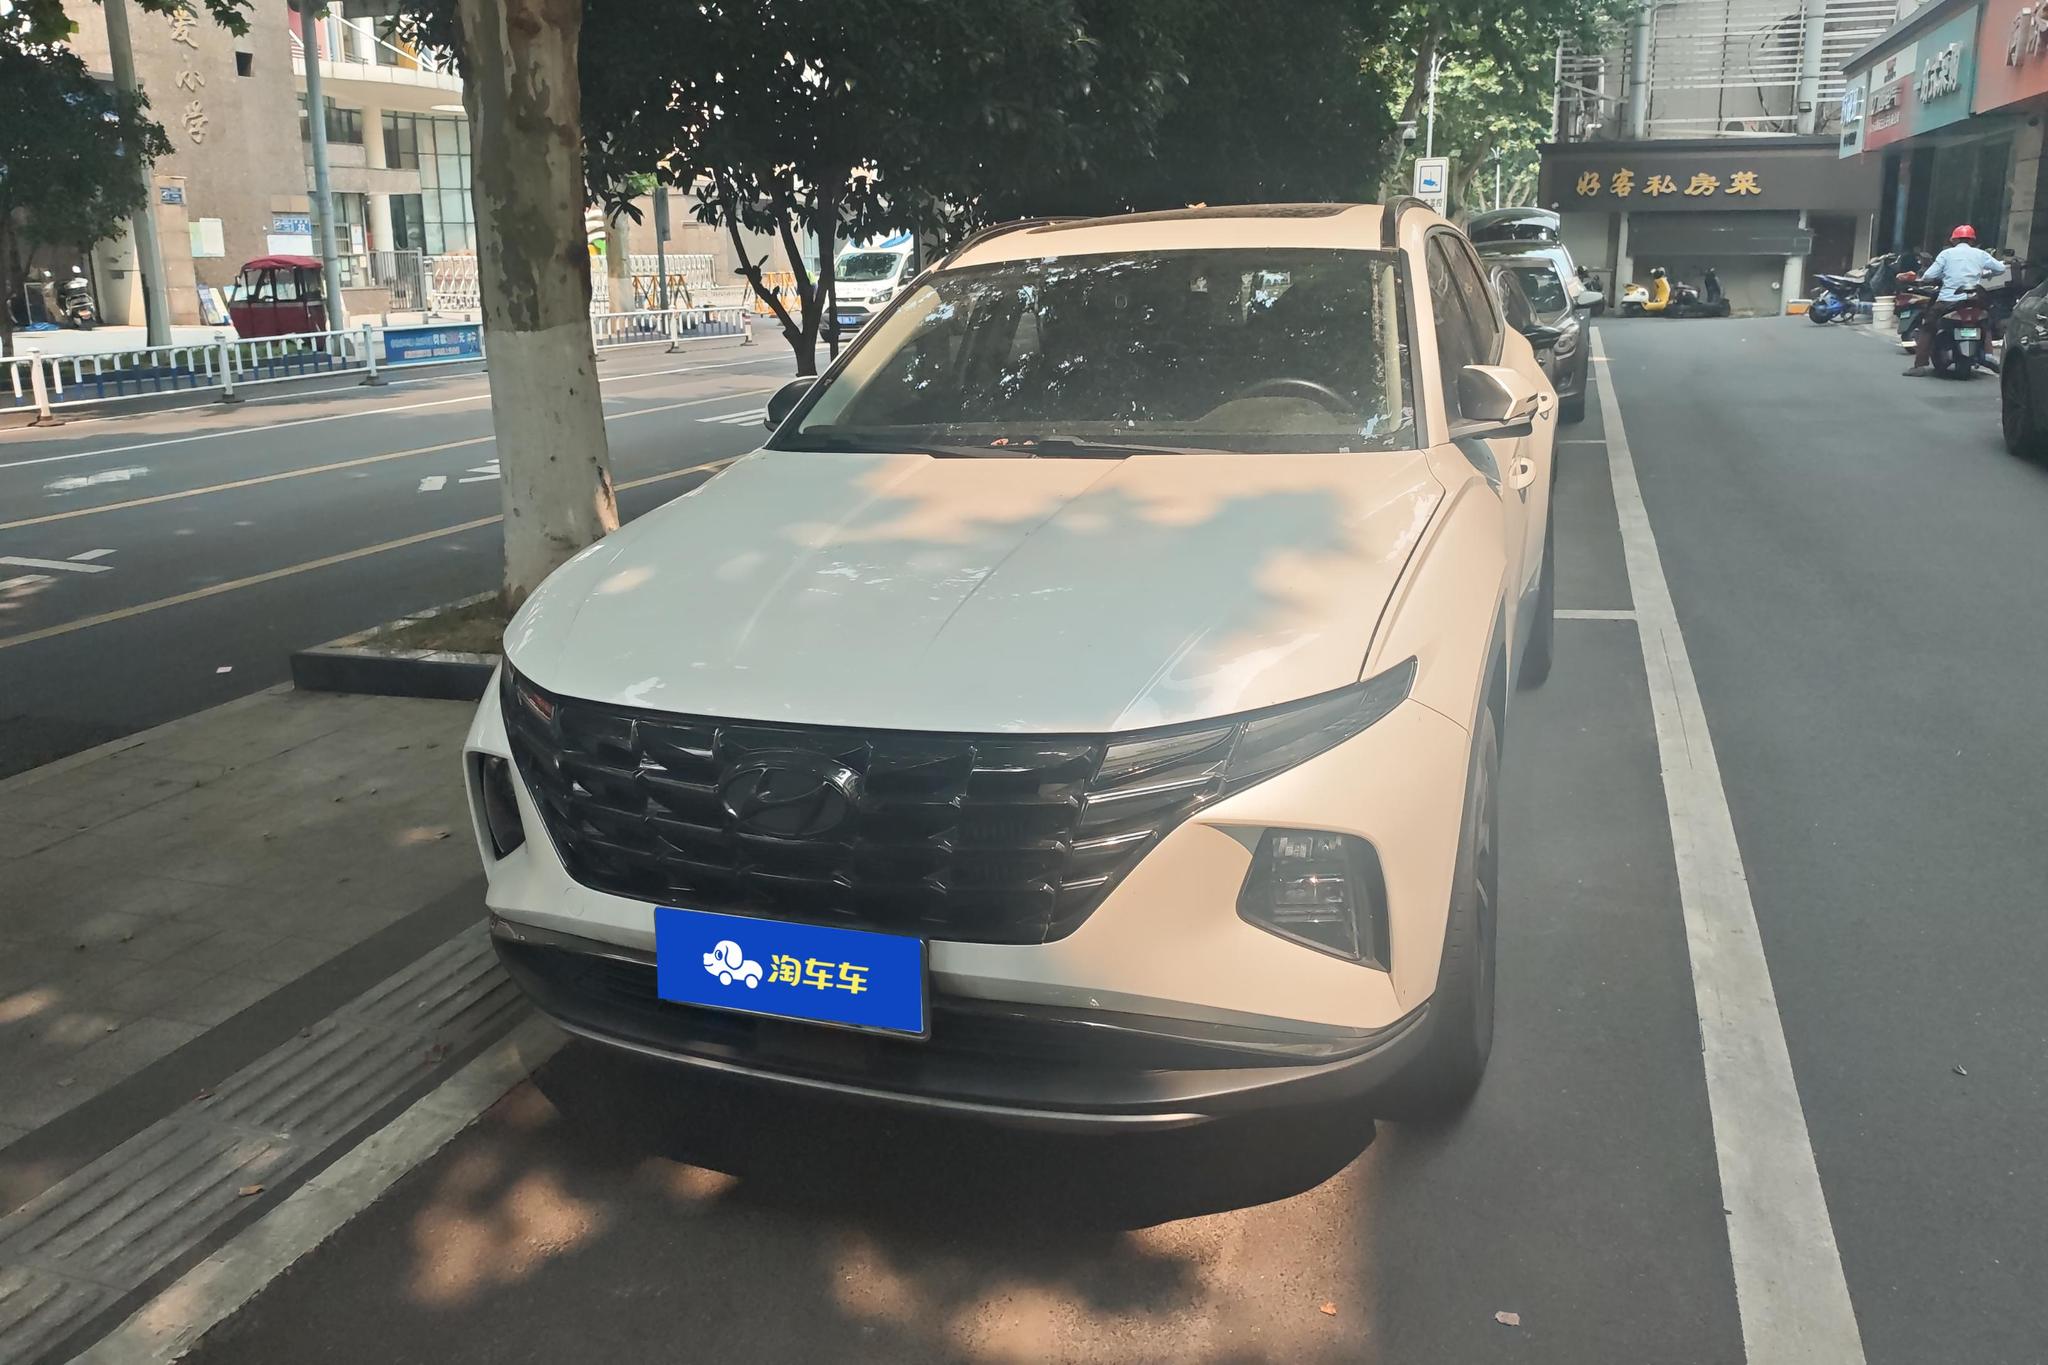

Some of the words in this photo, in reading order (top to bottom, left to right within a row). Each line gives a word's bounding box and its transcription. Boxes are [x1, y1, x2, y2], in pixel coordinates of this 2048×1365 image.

[1576, 168, 1762, 198] 好客私房菜
